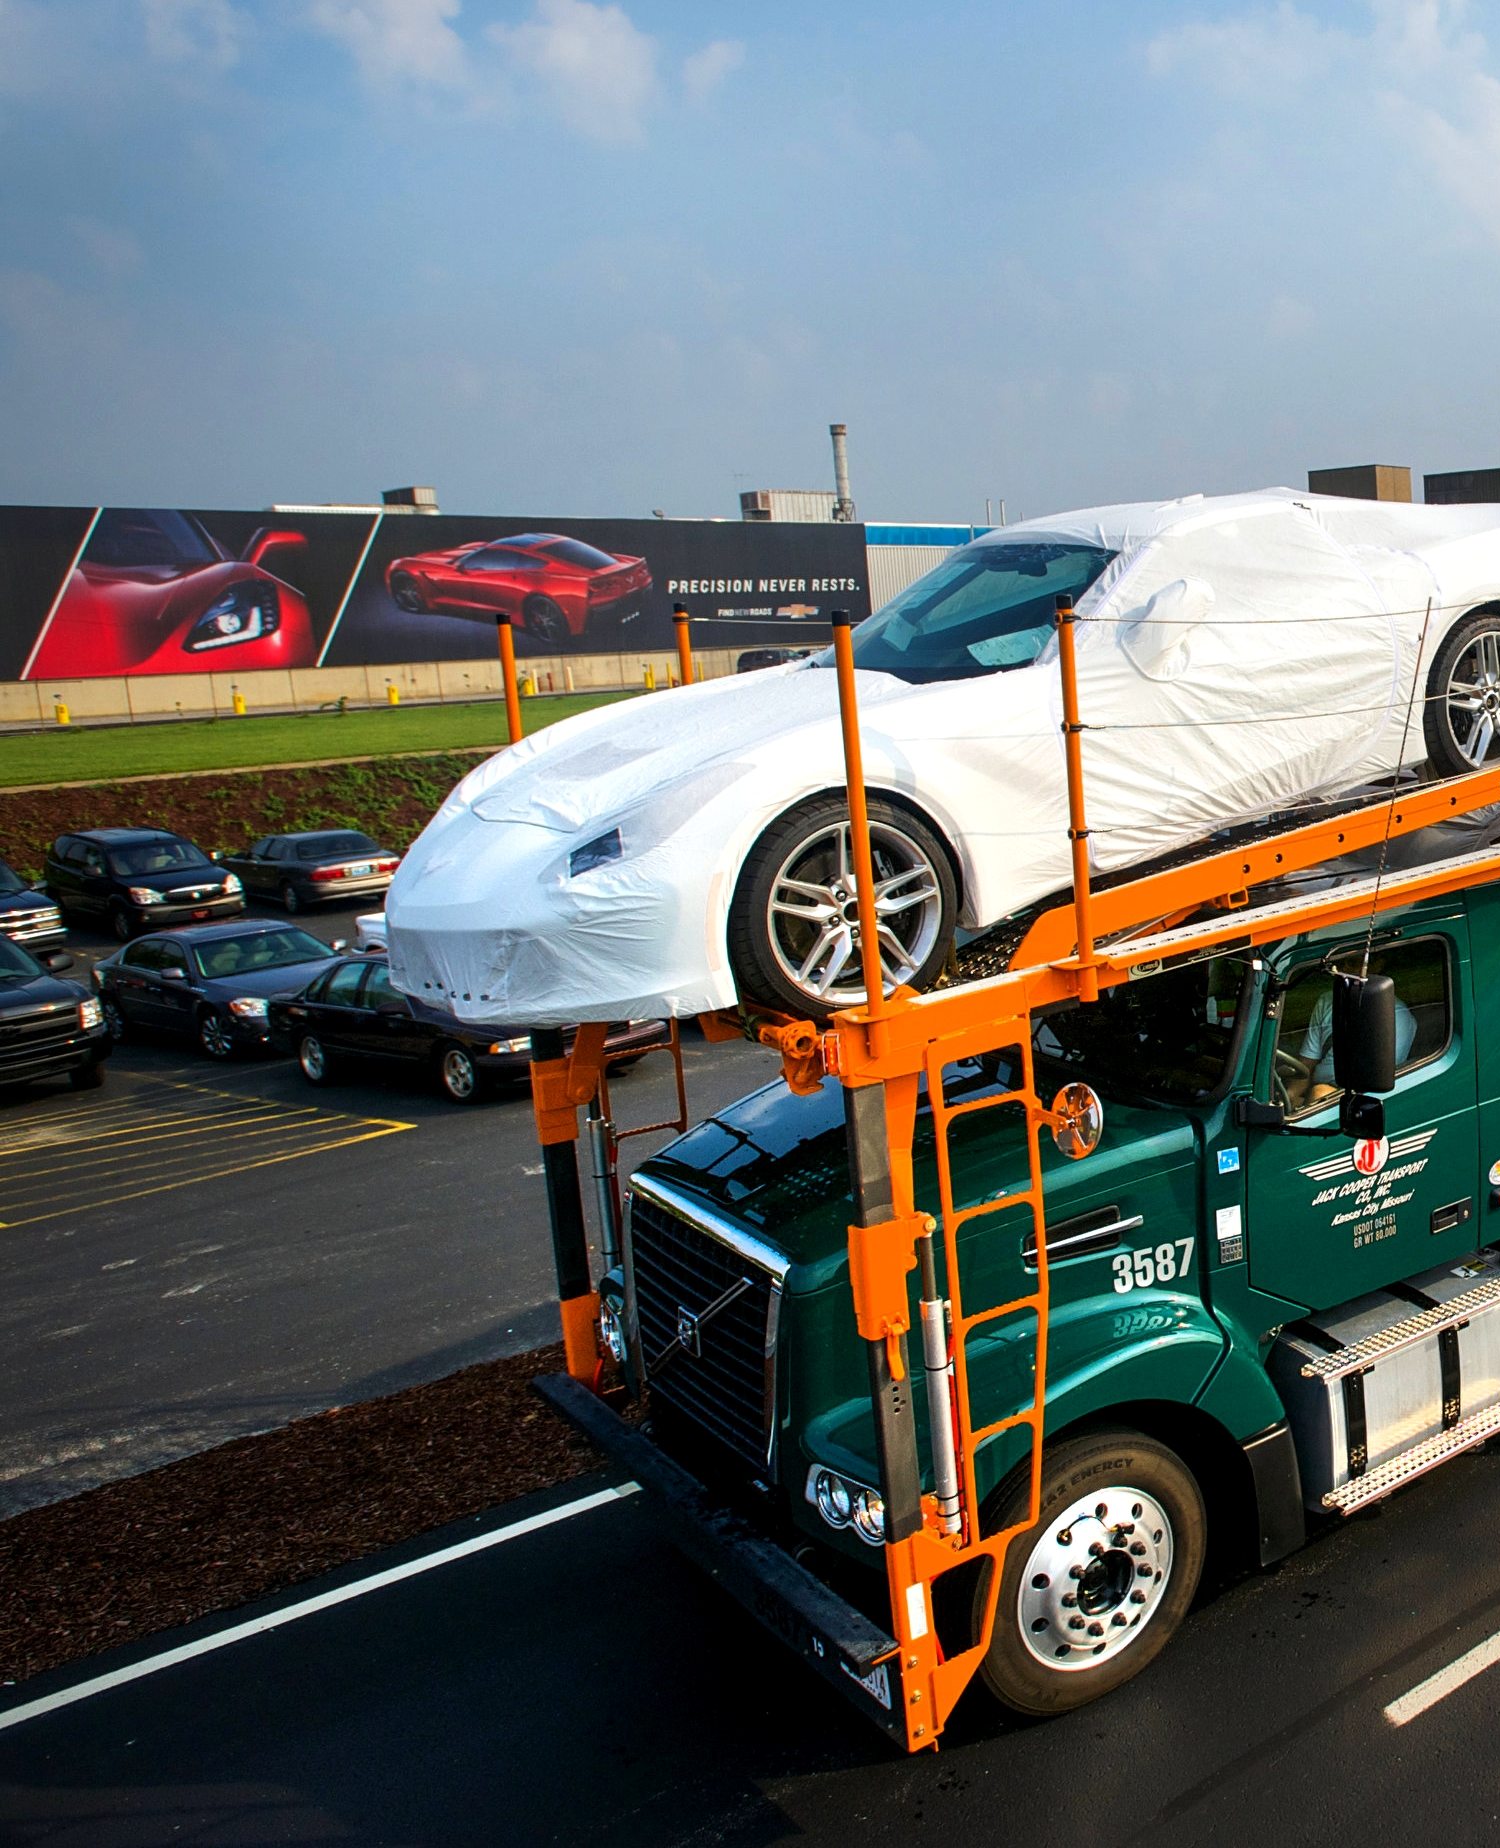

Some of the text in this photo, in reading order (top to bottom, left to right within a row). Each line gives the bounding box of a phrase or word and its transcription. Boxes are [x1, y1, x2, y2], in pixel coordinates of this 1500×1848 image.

[667, 578, 860, 594] PRECISION NEVER RESTS.
[1312, 1158, 1429, 1206] JACK COOPER TRANSPORT
[1331, 1209, 1362, 1226] Kansas
[1380, 1189, 1415, 1210] Missouri
[1354, 1220, 1373, 1236] USDOT
[1354, 1236, 1362, 1248] GR
[1364, 1232, 1374, 1244] WT
[1112, 1236, 1195, 1294] 3587
[1070, 1458, 1134, 1485] ENERGY
